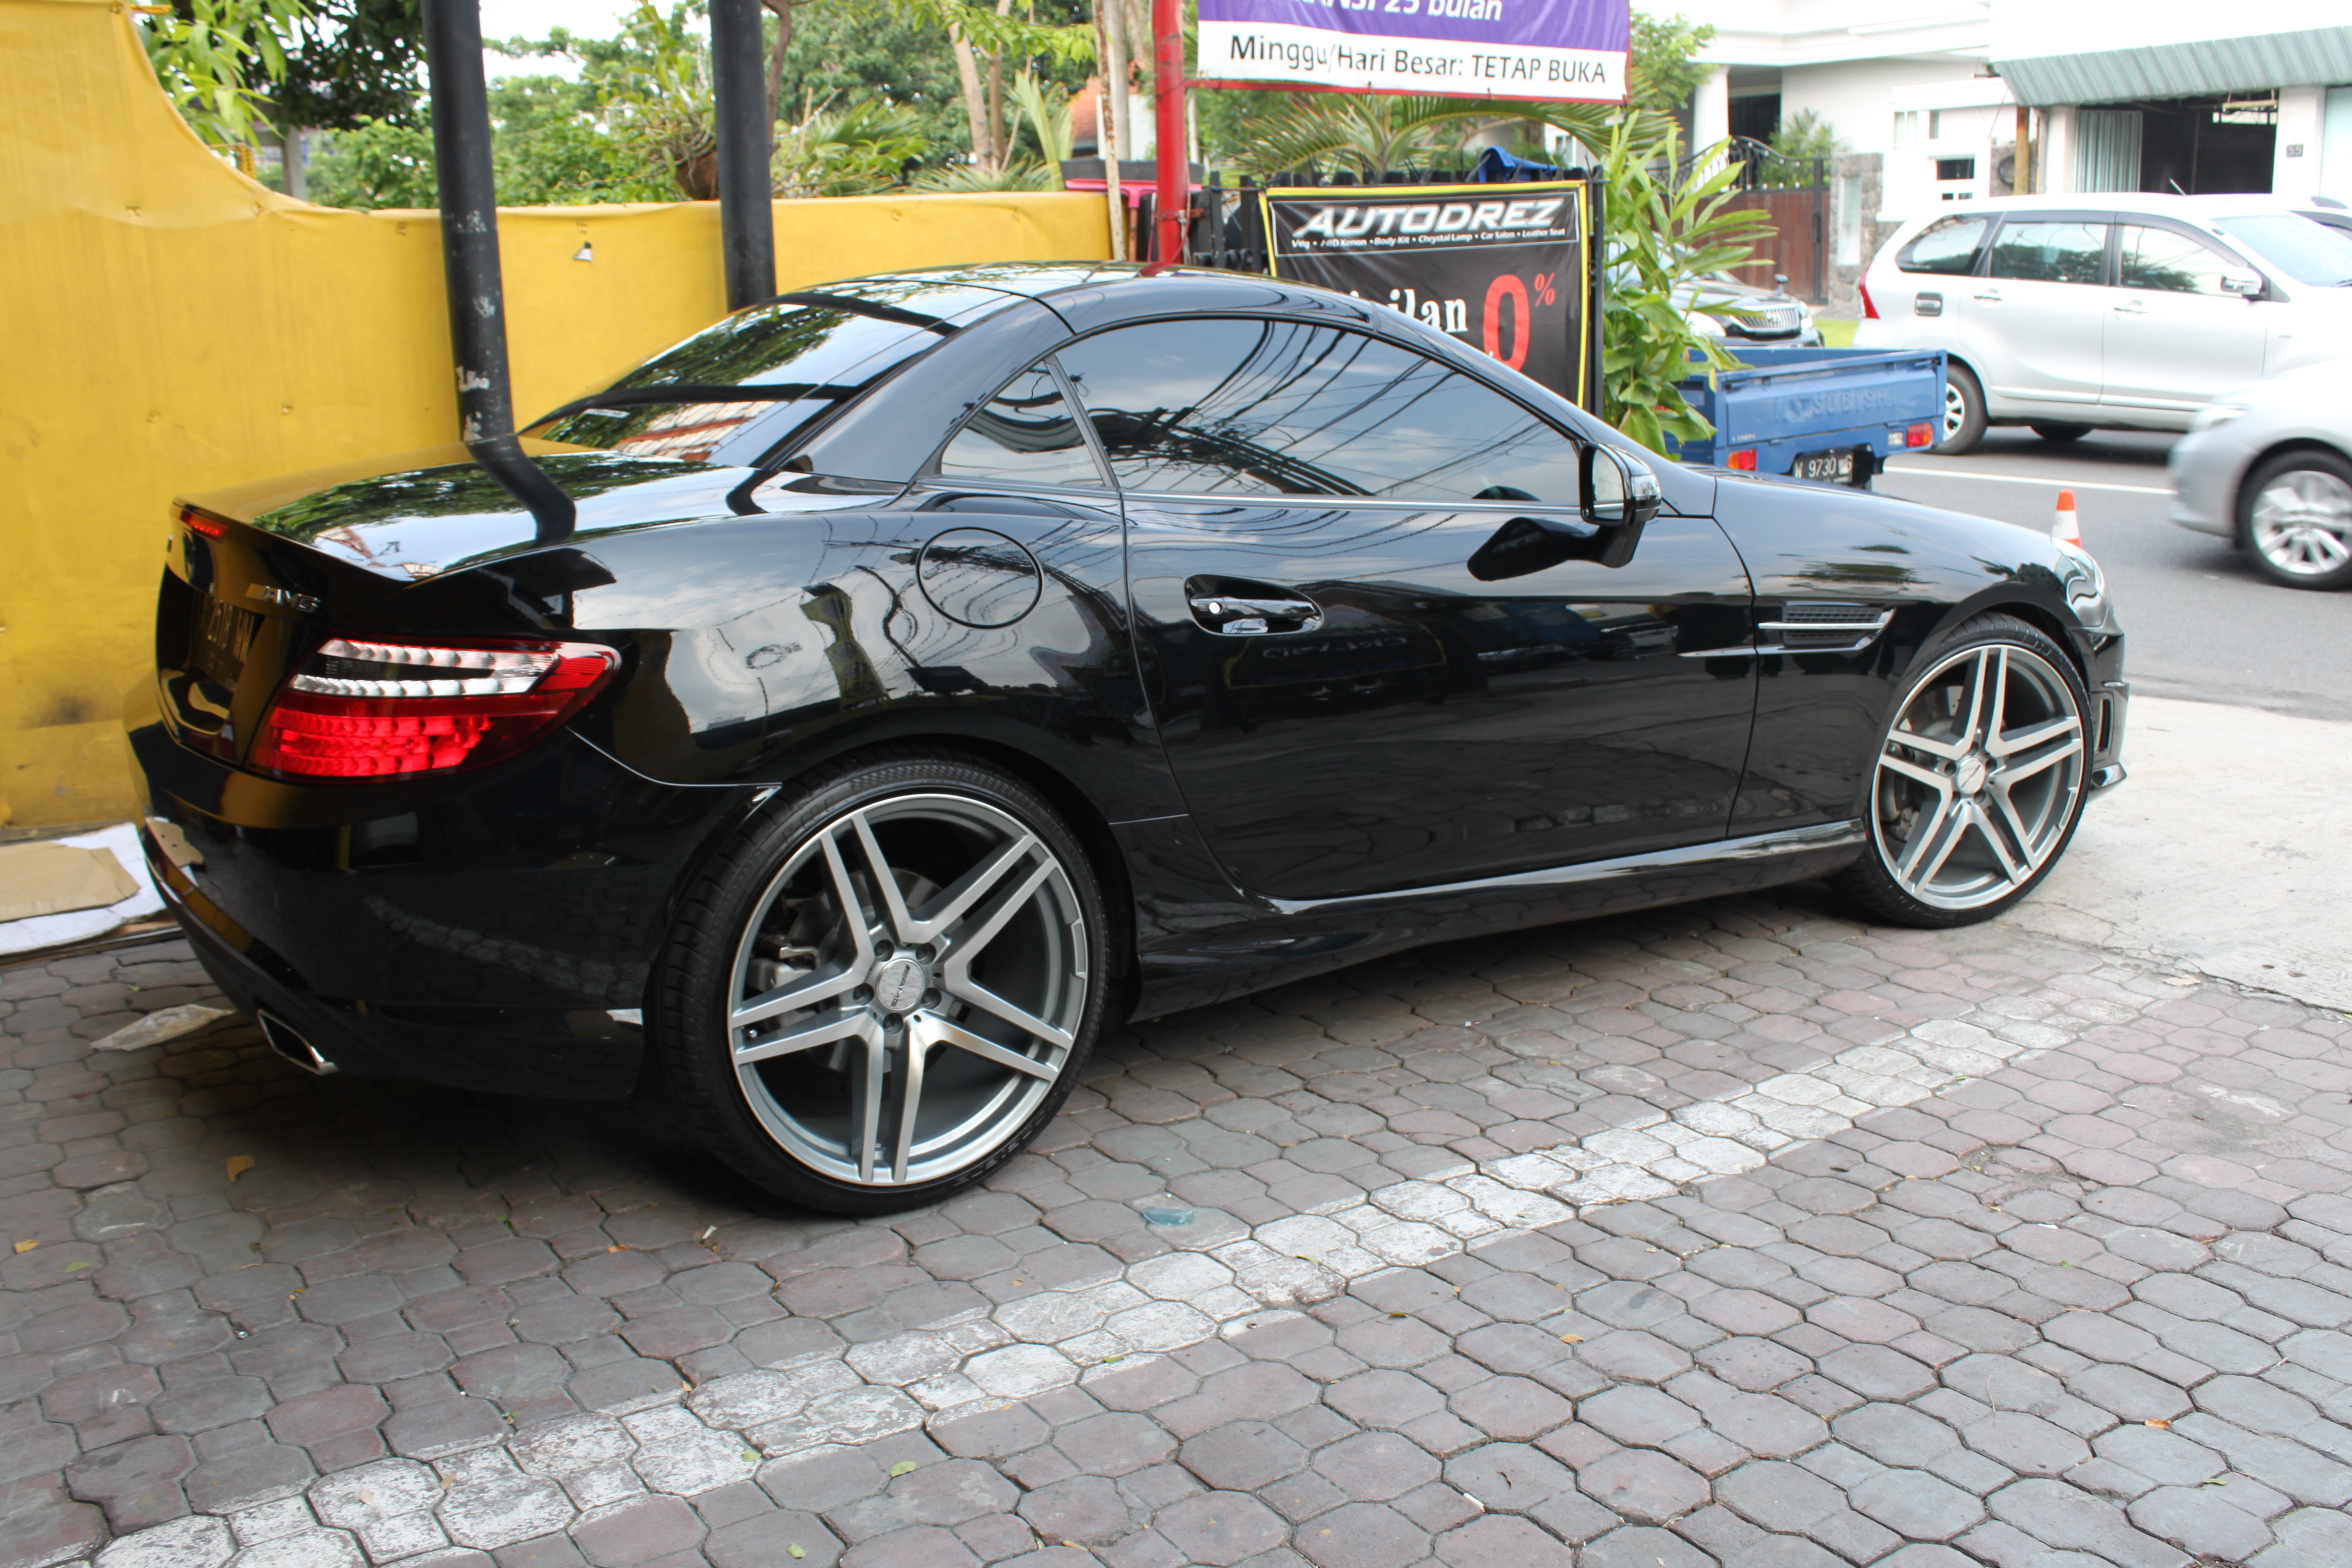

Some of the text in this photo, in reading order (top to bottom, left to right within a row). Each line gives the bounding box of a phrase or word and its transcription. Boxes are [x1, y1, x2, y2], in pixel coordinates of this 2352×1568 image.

[1230, 34, 1606, 83] Minggu/Hari Besar: TETAP BUKA
[1292, 197, 1564, 238] AUTODREZ
[1480, 231, 1495, 241] Car
[1808, 457, 1837, 478] 9730
